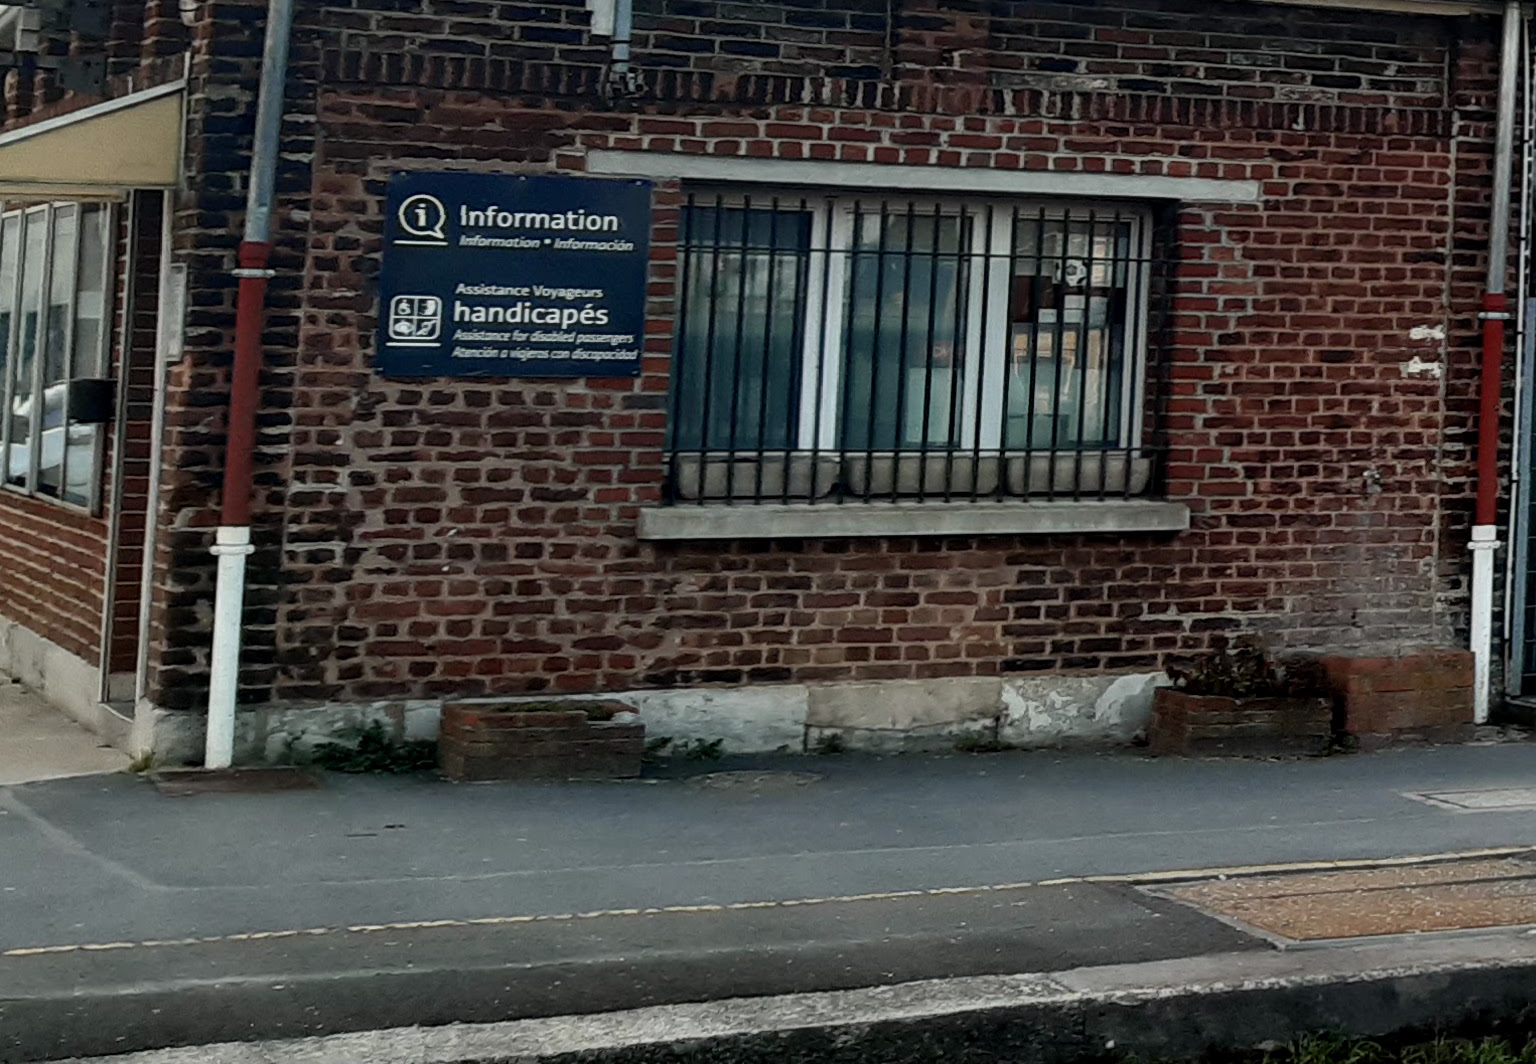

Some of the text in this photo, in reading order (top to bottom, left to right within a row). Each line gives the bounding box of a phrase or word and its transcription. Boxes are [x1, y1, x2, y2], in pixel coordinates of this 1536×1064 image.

[460, 204, 619, 232] Information
[458, 235, 634, 252] Information Información
[455, 283, 604, 301] Assistance Voyageurs
[453, 300, 609, 330] handicapés
[530, 330, 577, 343] disabled
